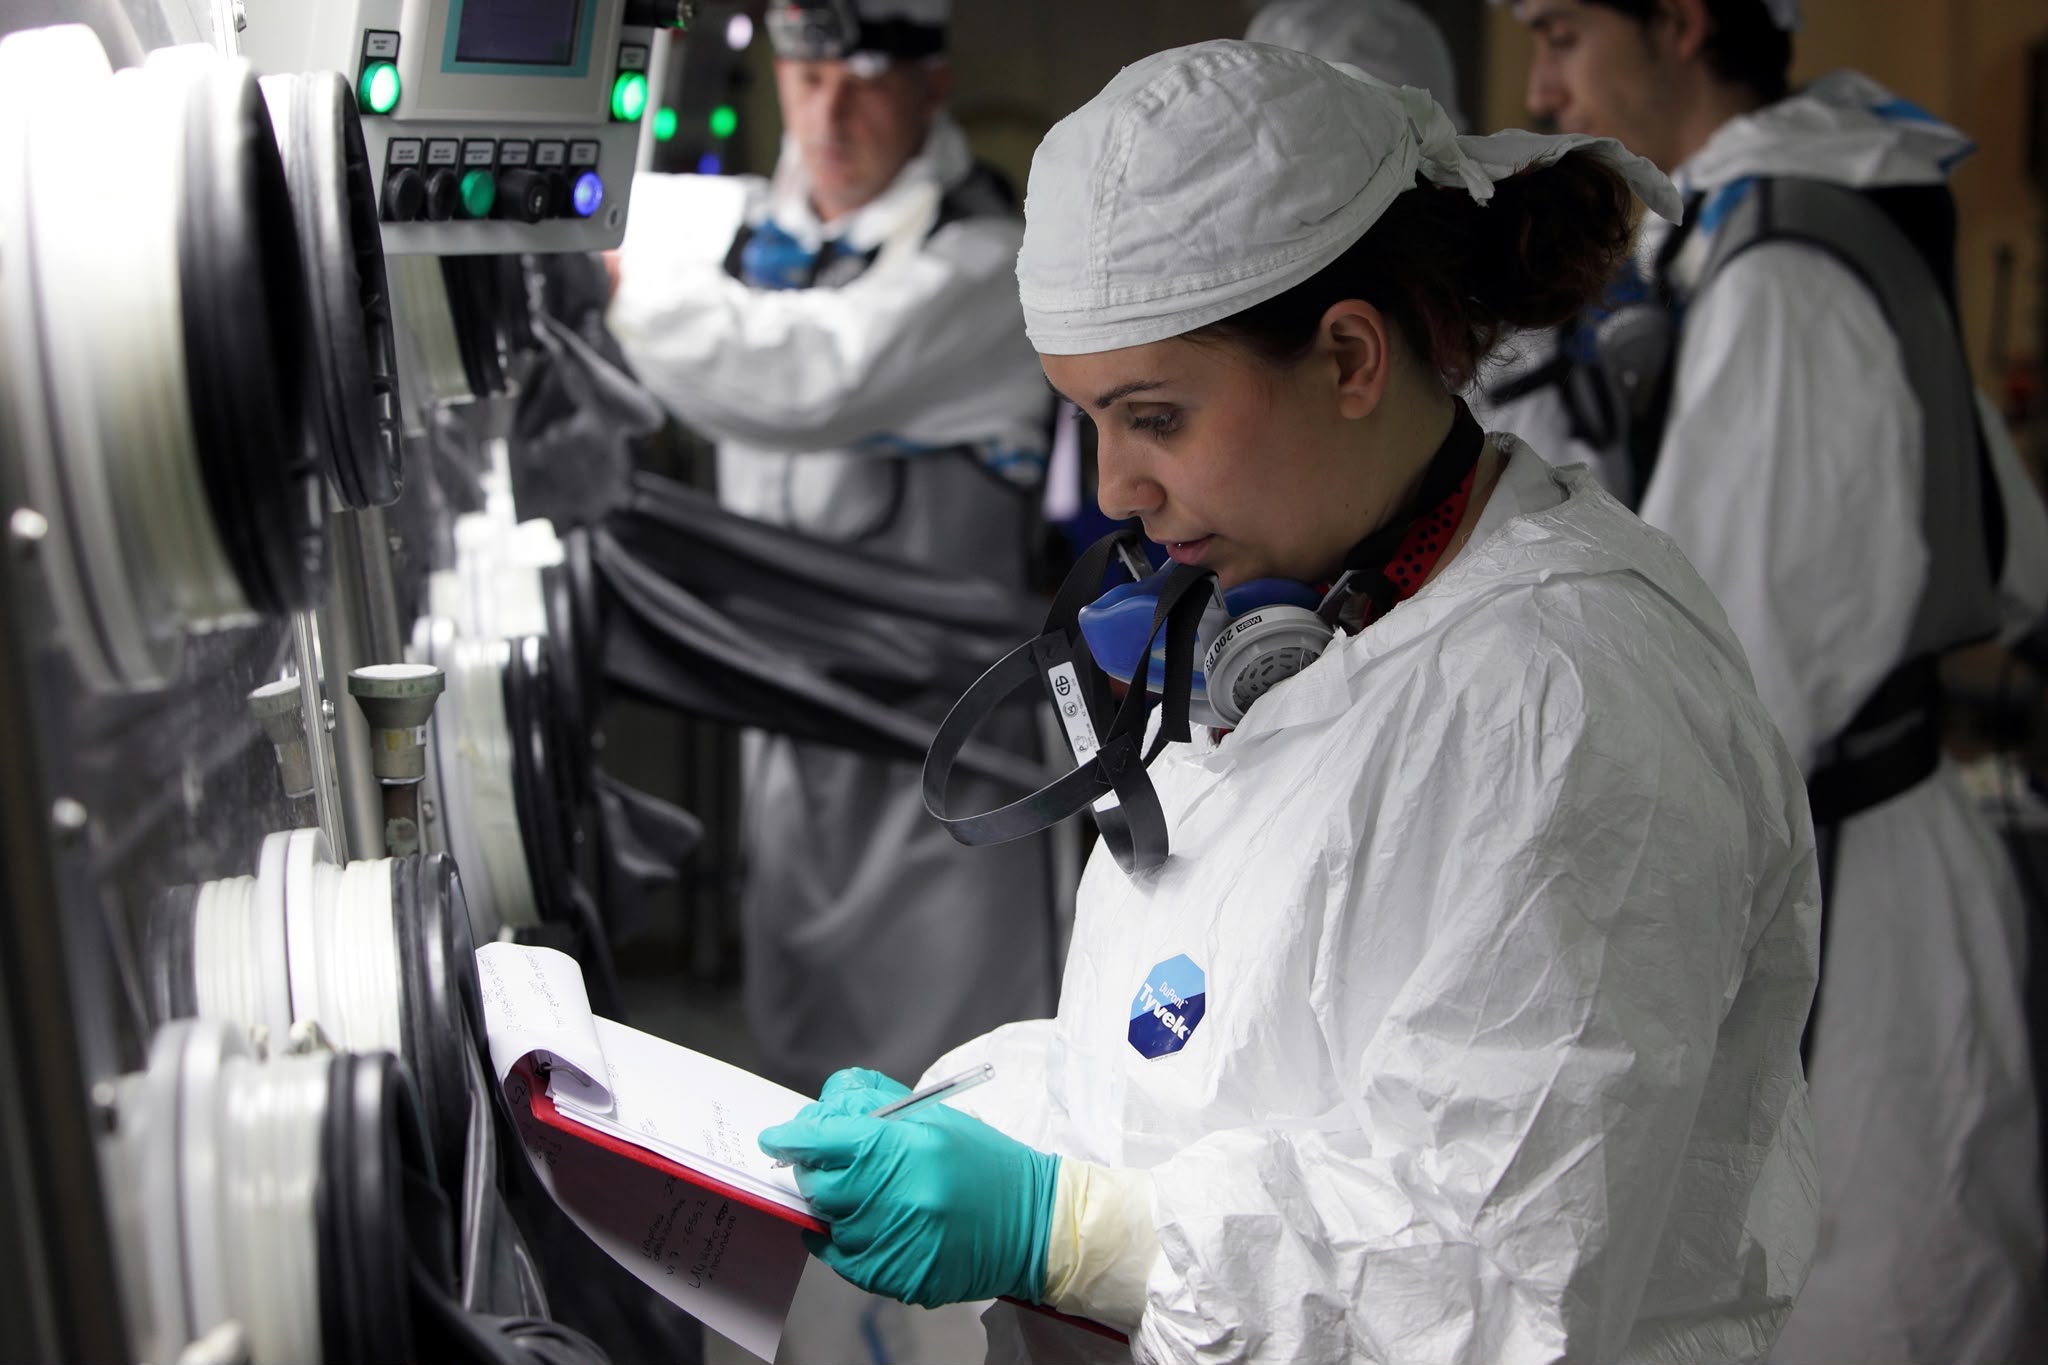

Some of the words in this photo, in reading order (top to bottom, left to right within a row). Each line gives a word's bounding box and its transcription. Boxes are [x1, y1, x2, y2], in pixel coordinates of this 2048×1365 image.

[1236, 616, 1262, 633] MSA
[1214, 629, 1234, 653] 200
[1159, 981, 1185, 1009] DuPont
